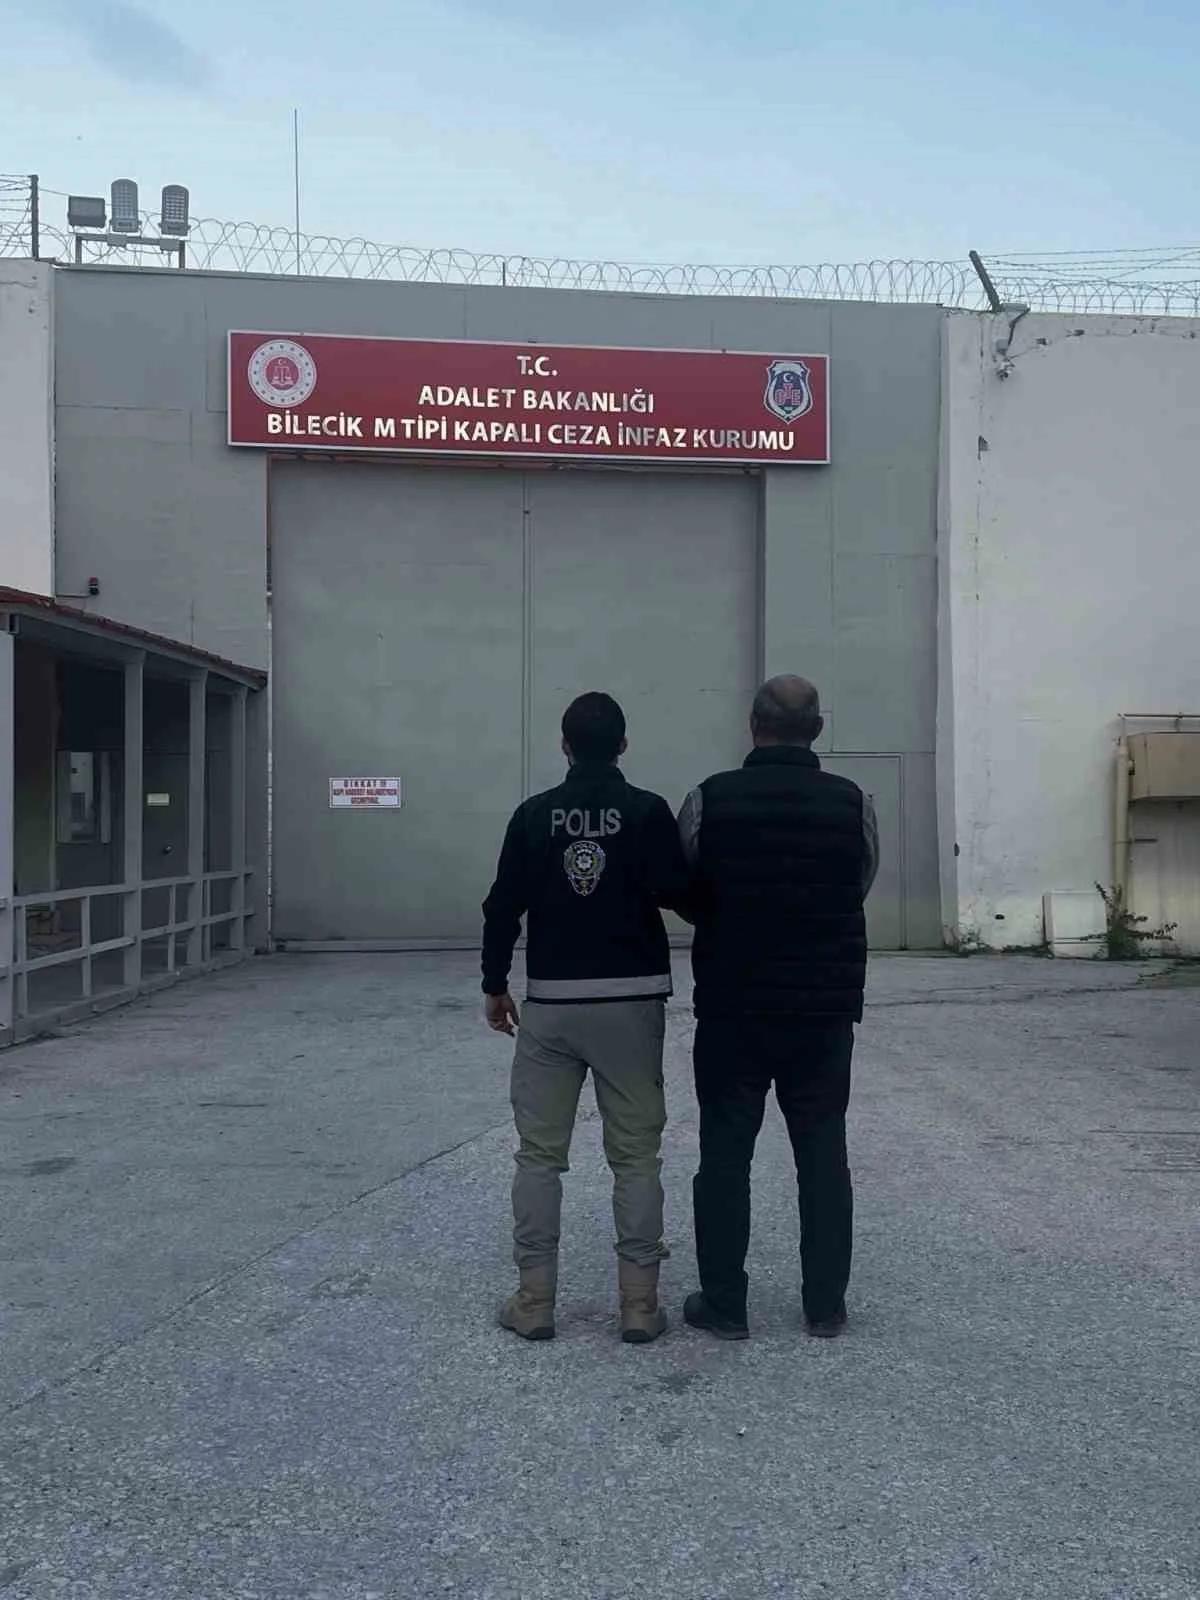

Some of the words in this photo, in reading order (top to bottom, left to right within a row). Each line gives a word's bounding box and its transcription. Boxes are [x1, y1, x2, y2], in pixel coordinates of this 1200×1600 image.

[516, 355, 558, 376] T.C.
[418, 385, 516, 409] ADALET
[523, 388, 654, 413] BAKANLIĞI
[266, 410, 364, 438] BİLECİK
[374, 417, 395, 437] M
[401, 414, 447, 440] TİPİ
[454, 420, 541, 443] KAPALI
[548, 424, 611, 446] CEZA
[618, 421, 686, 448] İNFAZ
[693, 428, 795, 451] KURUMU
